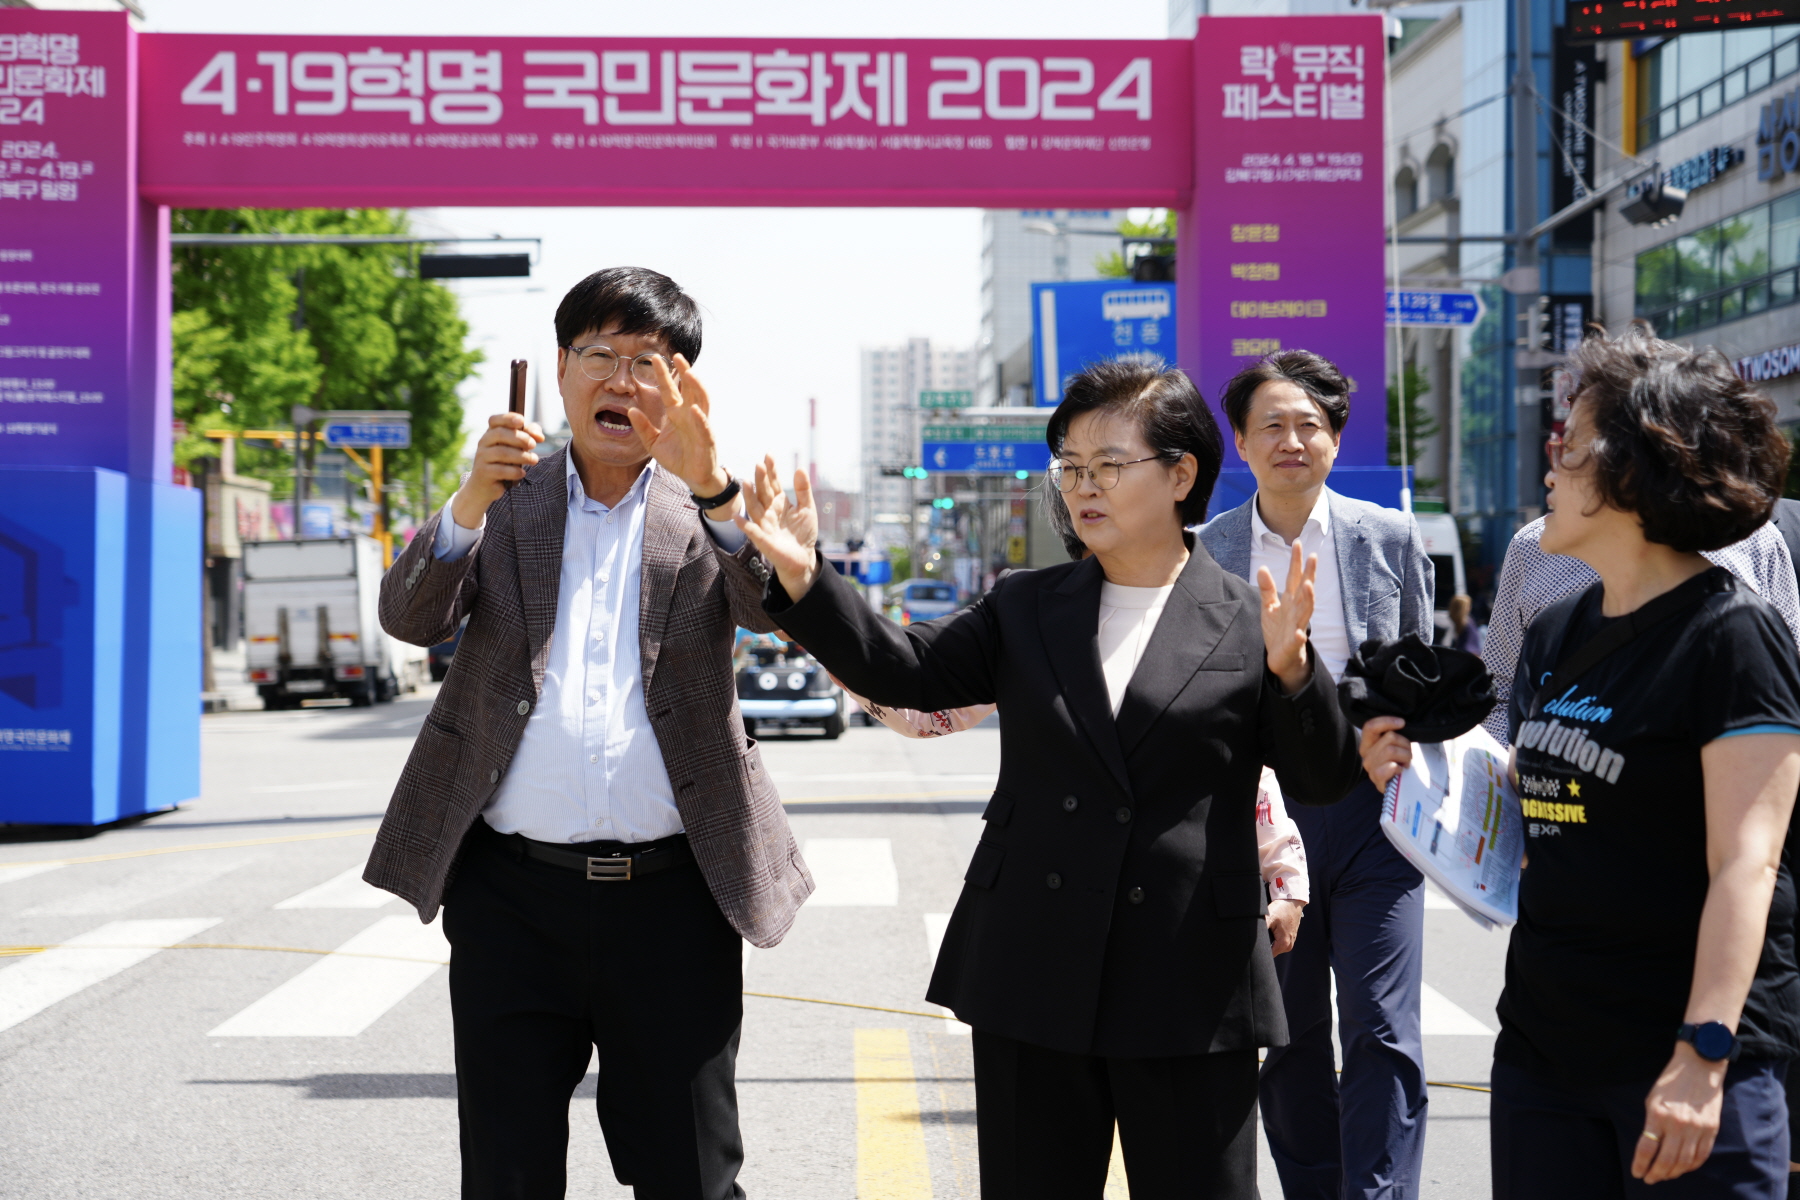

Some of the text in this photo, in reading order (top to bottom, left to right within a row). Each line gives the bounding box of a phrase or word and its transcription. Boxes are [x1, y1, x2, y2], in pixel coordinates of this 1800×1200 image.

[1240, 45, 1277, 82] 락
[1292, 45, 1365, 82] 뮤직
[524, 48, 908, 126] 국민문화제
[927, 57, 1152, 121] 2024
[1222, 83, 1365, 120] 페스티벌
[0, 97, 44, 126] 24
[0, 180, 38, 200] 북구
